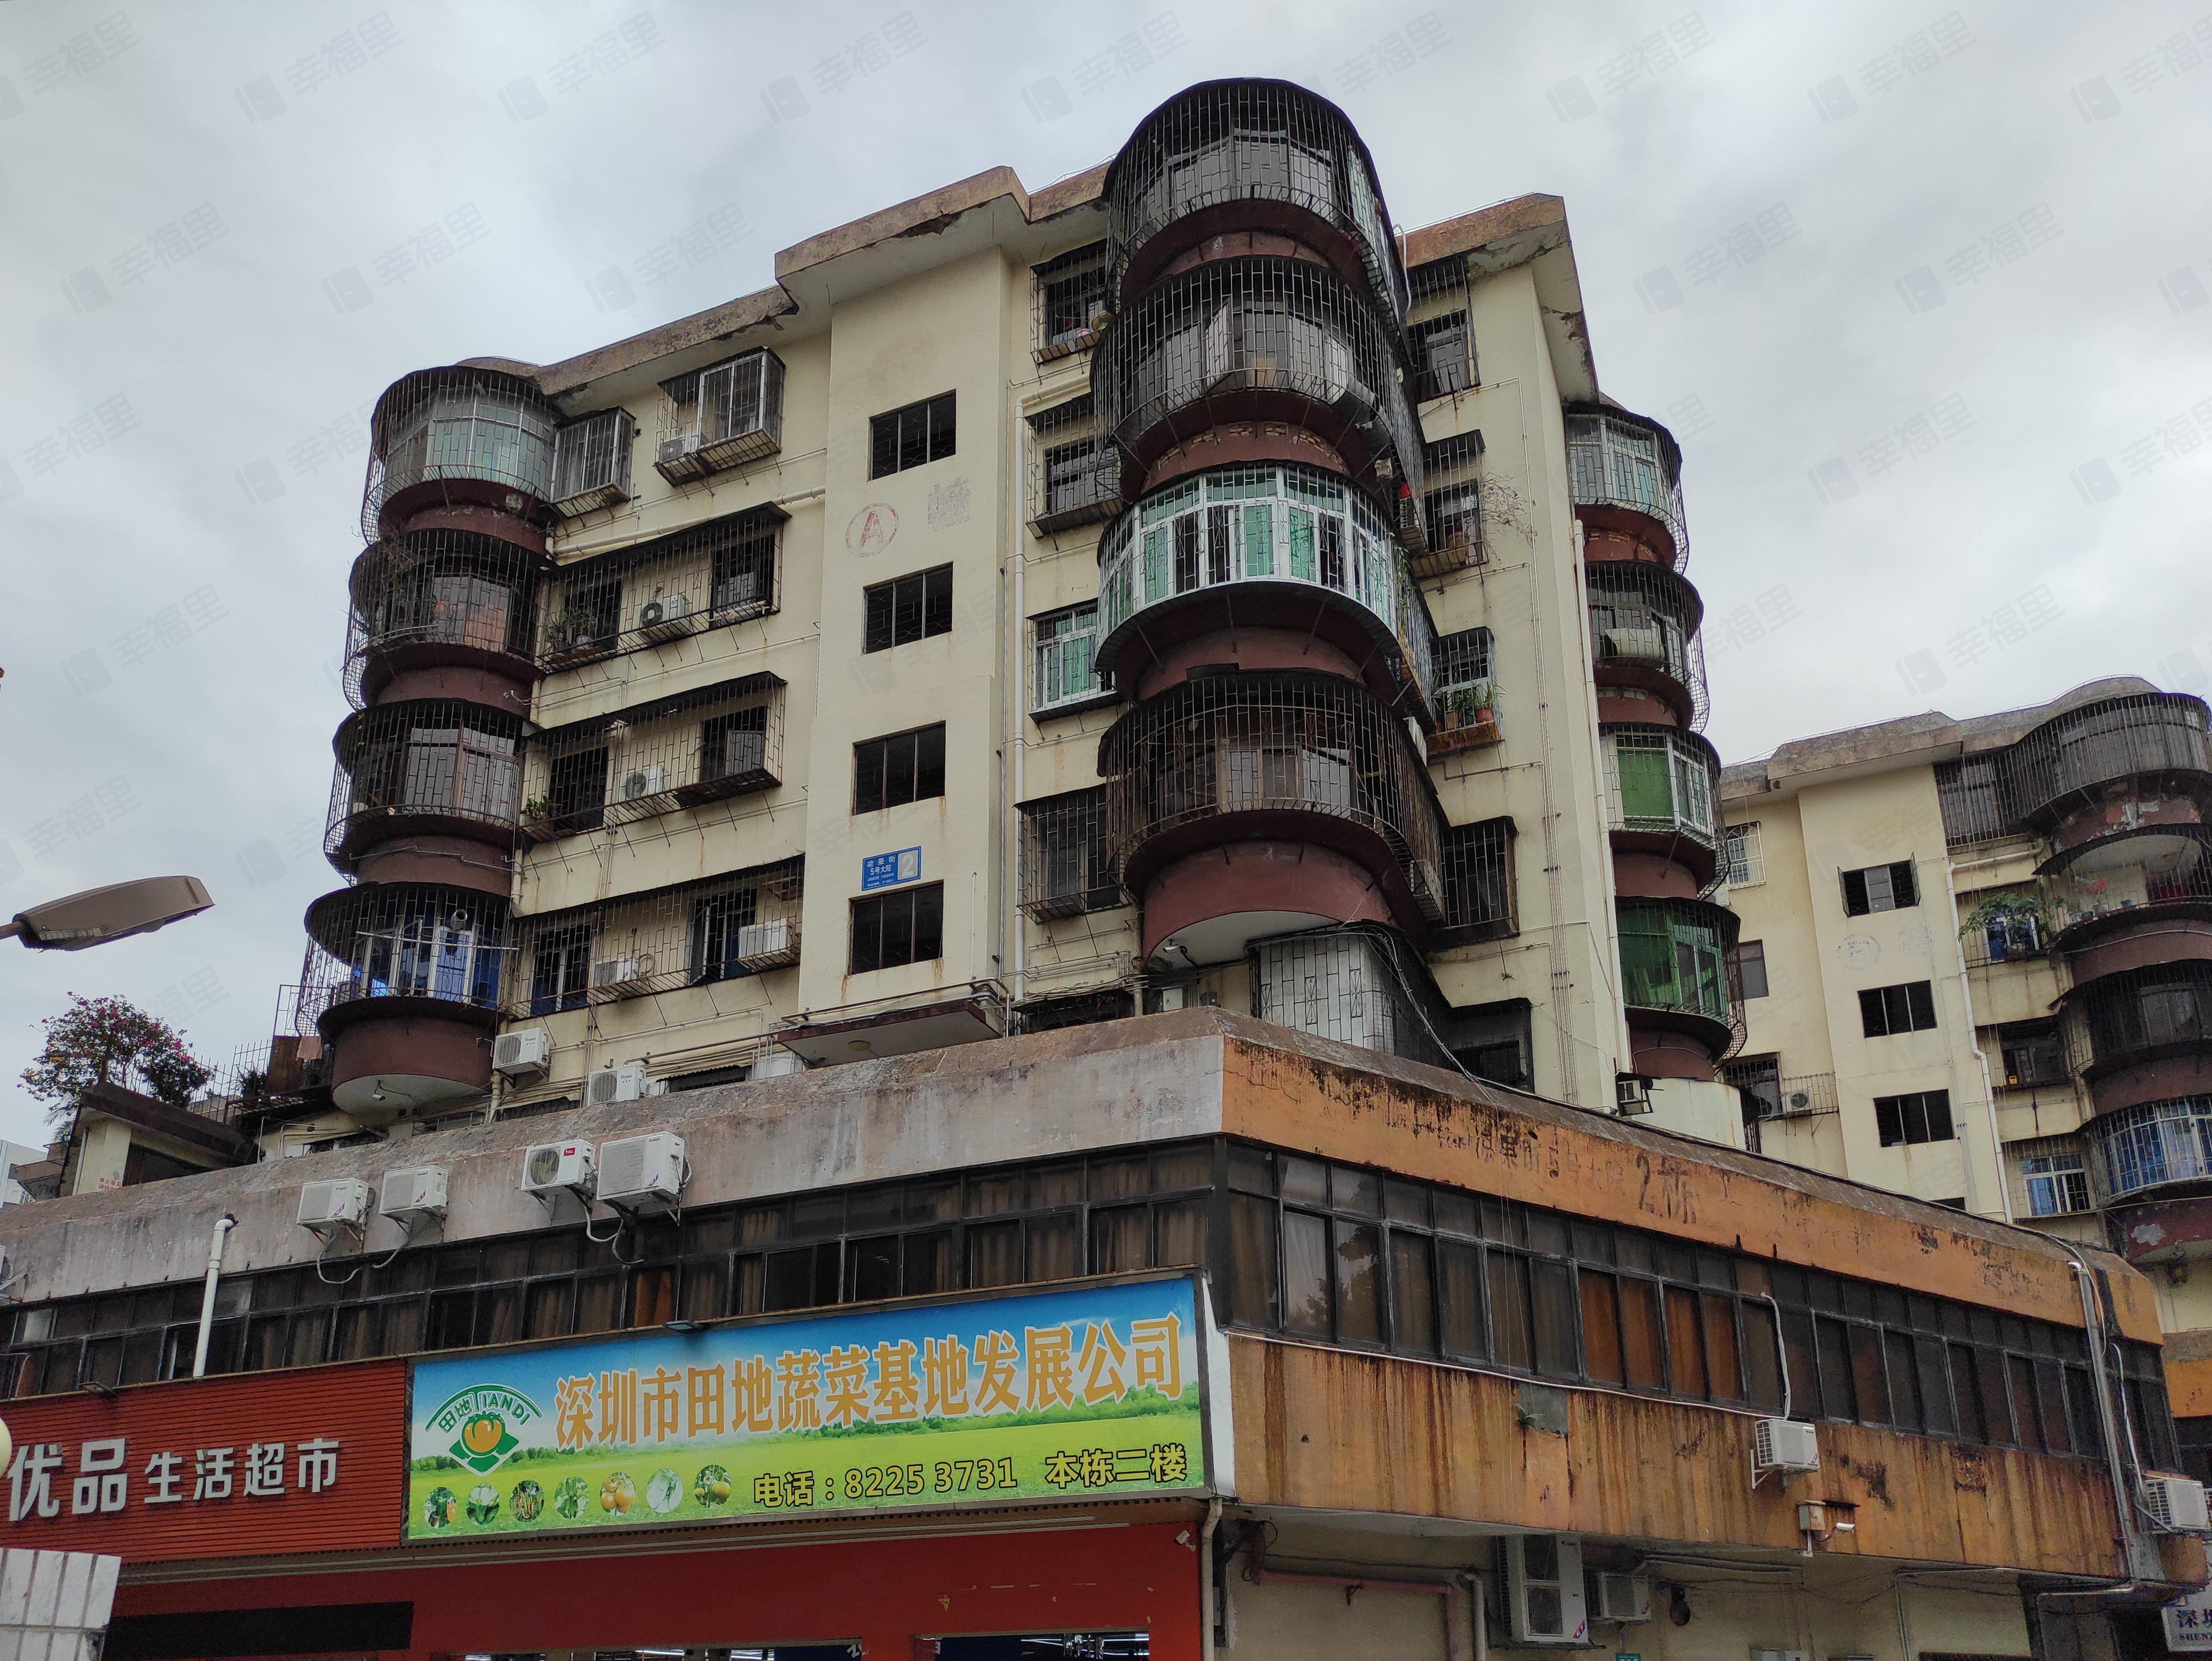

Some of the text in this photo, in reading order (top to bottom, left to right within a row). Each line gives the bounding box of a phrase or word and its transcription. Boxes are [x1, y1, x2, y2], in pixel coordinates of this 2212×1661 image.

[902, 853, 914, 877] 2
[555, 1311, 1182, 1451] 深圳市田地蔬菜基地发展公司
[437, 1397, 472, 1434] 田地
[7, 1438, 340, 1522] 优品 生活超市
[1045, 1443, 1187, 1489] 本栋二楼
